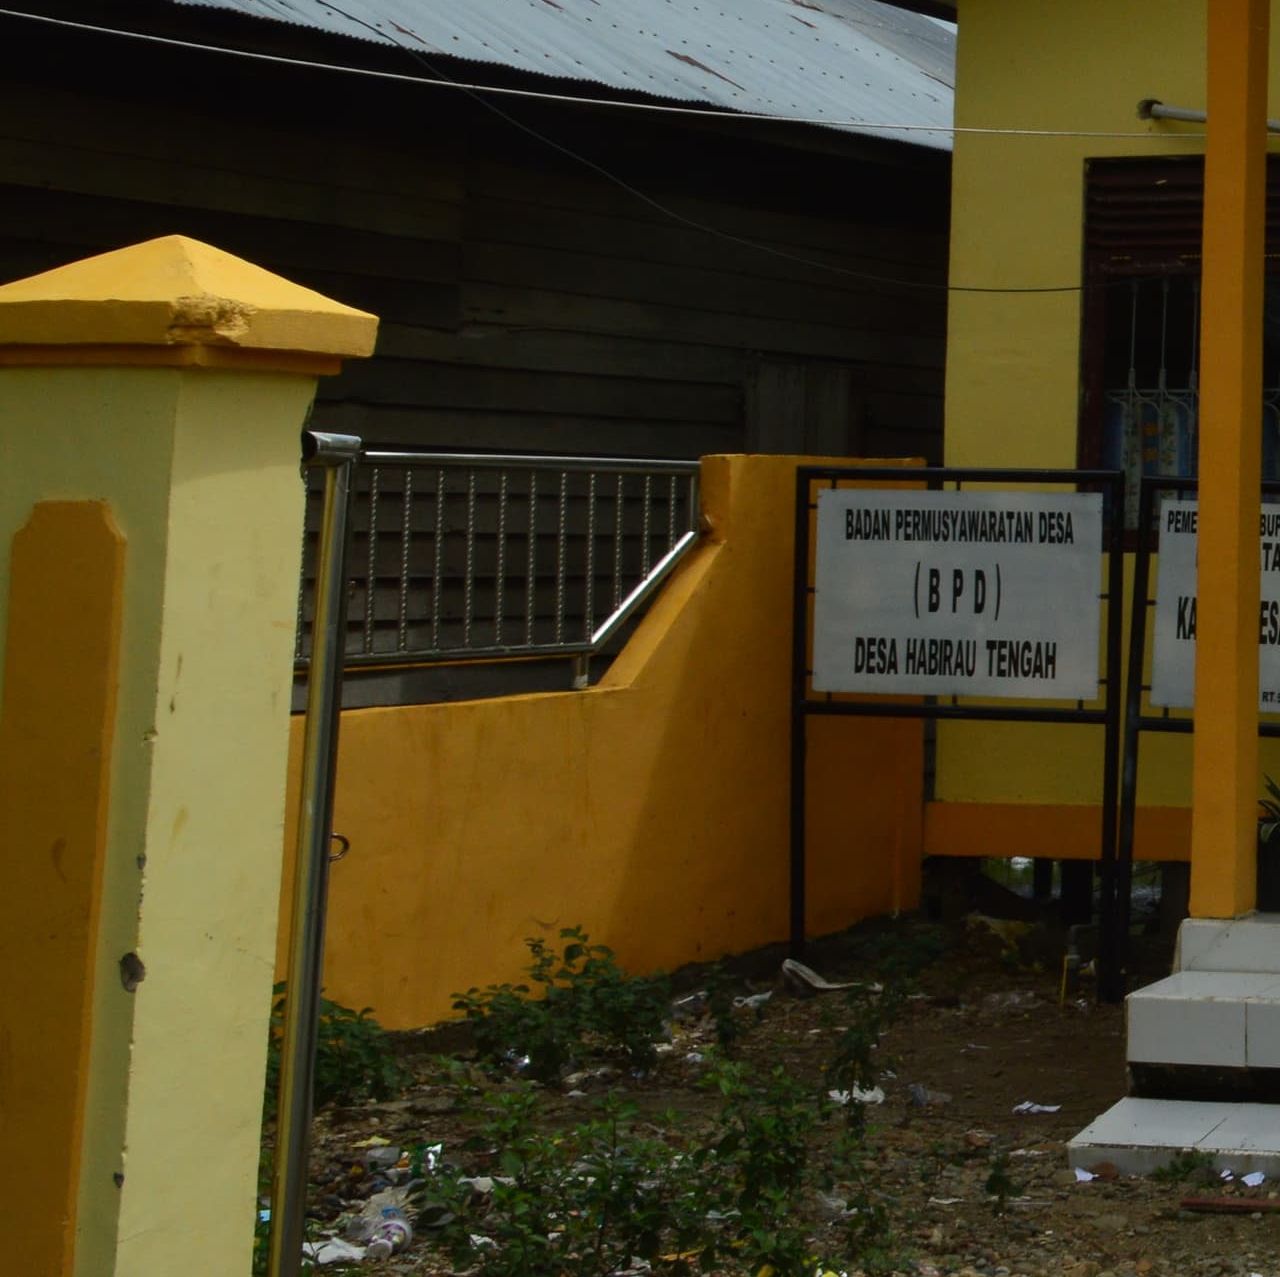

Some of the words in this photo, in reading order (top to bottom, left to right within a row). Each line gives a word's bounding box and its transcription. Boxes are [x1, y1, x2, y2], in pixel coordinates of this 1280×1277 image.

[846, 509, 891, 541] BADAN
[895, 509, 1033, 543] PERMUSYAWARATAN
[1038, 511, 1075, 545] DESA
[854, 637, 898, 674] DESA
[905, 638, 976, 677] HABIRAU
[986, 640, 1057, 679] TENGAH
